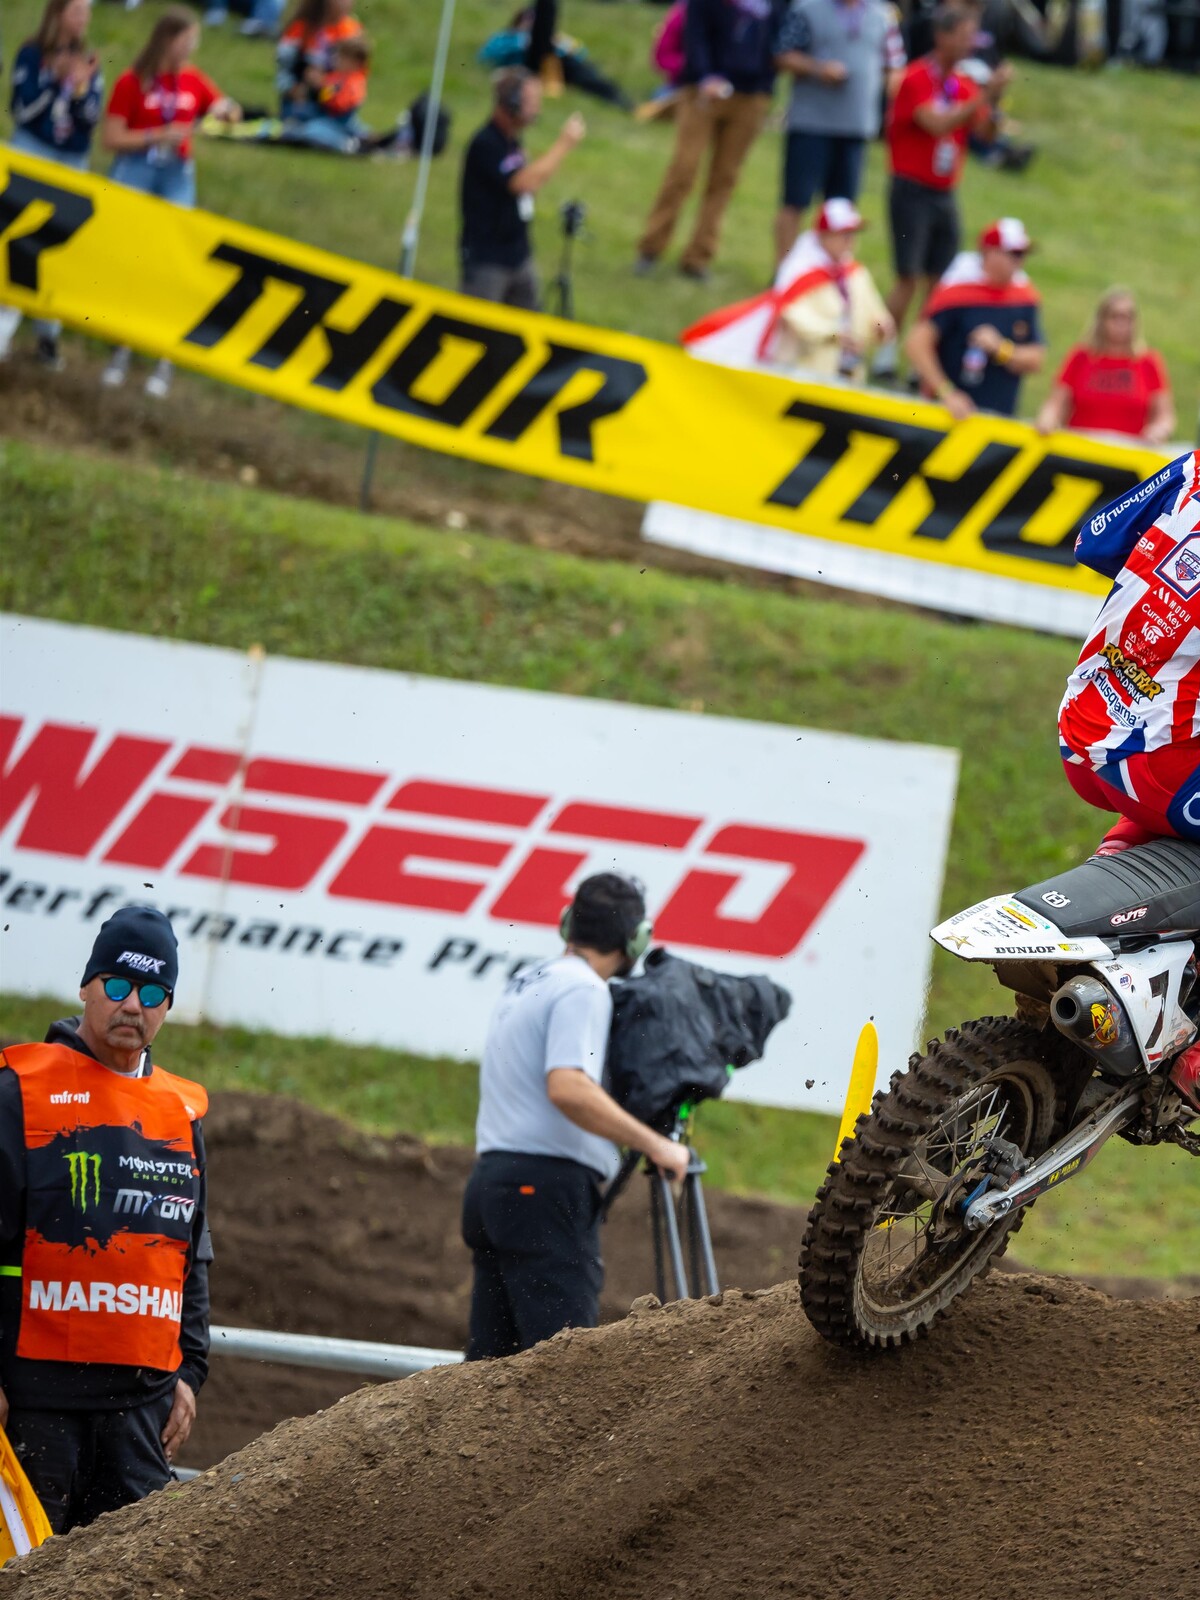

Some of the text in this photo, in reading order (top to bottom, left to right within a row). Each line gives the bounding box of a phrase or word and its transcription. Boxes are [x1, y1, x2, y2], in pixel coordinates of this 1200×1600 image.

[184, 243, 648, 462] THOR
[764, 400, 1142, 567] THO
[1166, 611, 1182, 630] Key
[1168, 600, 1191, 623] MODU
[1141, 621, 1160, 645] kps
[1098, 642, 1165, 702] ROSTAR
[0, 868, 406, 968] erfrmance
[1110, 907, 1148, 925] GUTS
[994, 946, 1056, 954] DUNLOP
[116, 951, 166, 974] PRMX
[1145, 969, 1169, 1049] 7
[133, 1173, 185, 1186] ENERGY
